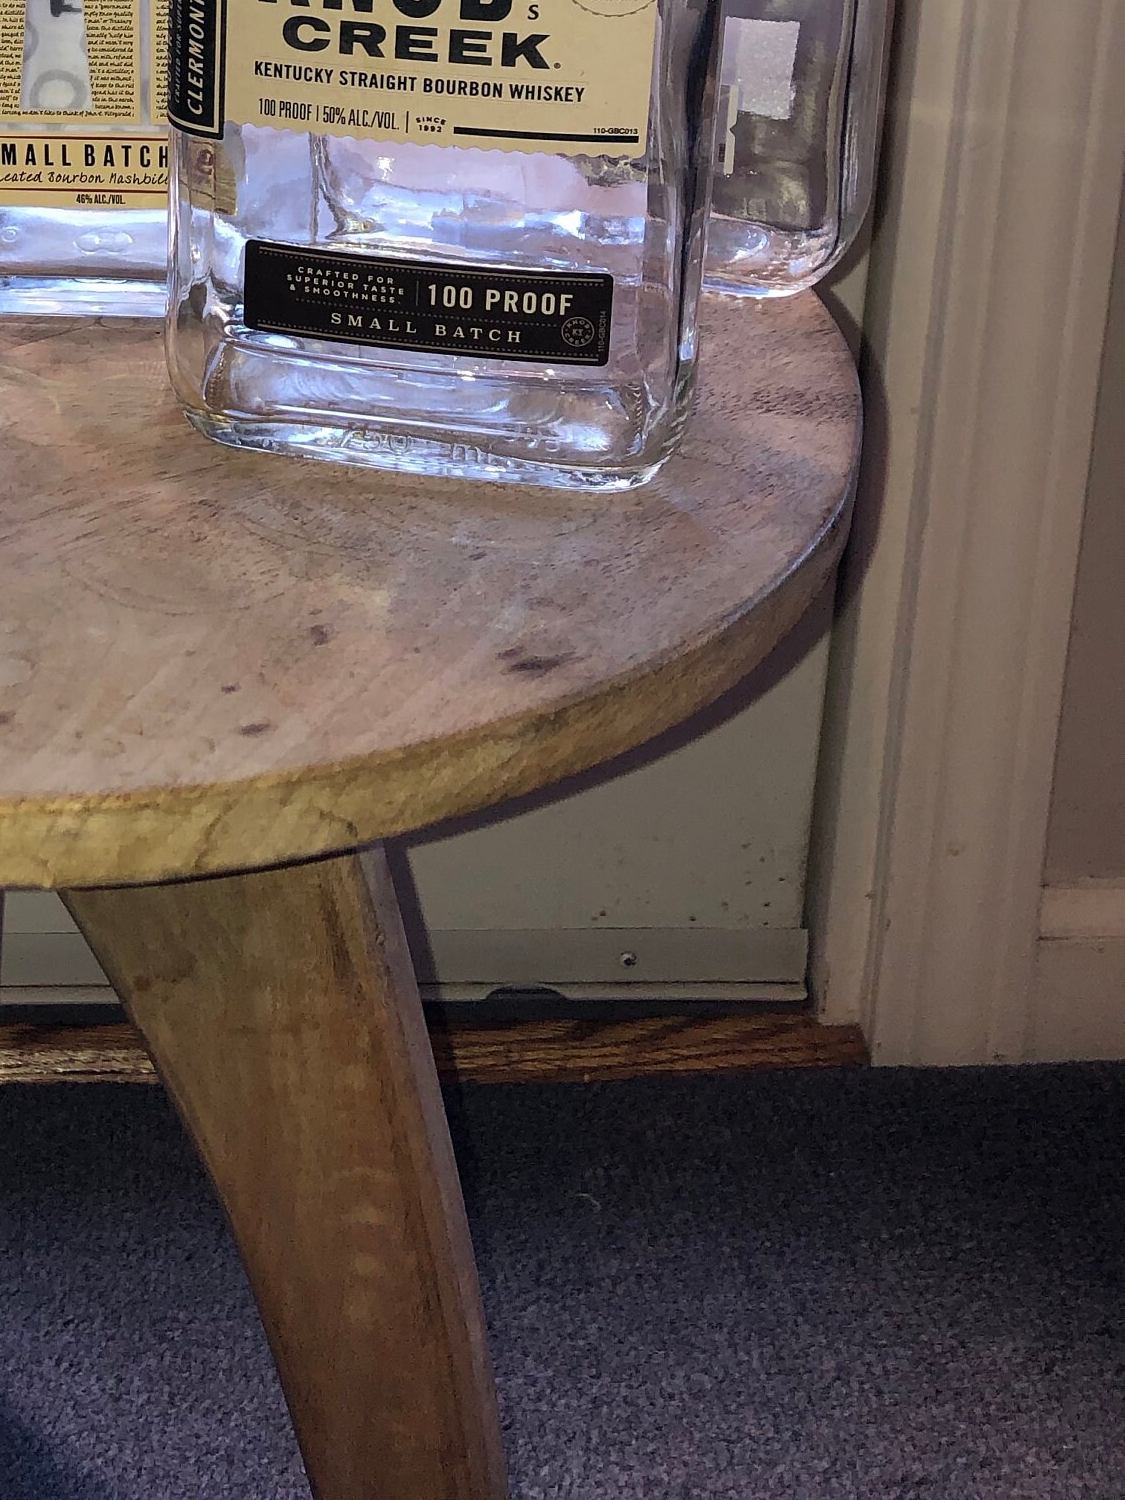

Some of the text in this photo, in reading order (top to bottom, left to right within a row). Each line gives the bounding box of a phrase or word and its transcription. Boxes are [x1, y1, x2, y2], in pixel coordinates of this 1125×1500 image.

[282, 15, 551, 70] CREEK
[254, 60, 585, 103] KENTUCKY STRAIGHT BOURBON WHISKEY
[259, 98, 400, 131] 100 PROOF 50% ALC./VOL.
[415, 116, 446, 126] SINCE
[419, 125, 443, 133] 1992
[84, 144, 168, 168] BATCH
[47, 171, 105, 184] Bourbon
[76, 193, 93, 204] 46%
[286, 274, 404, 295] SUPERIOR TASTE
[297, 266, 394, 285] CRAFTED FOR
[289, 283, 296, 291] &
[428, 283, 574, 318] 100 PROOF
[330, 312, 523, 345] SMALL BATCH
